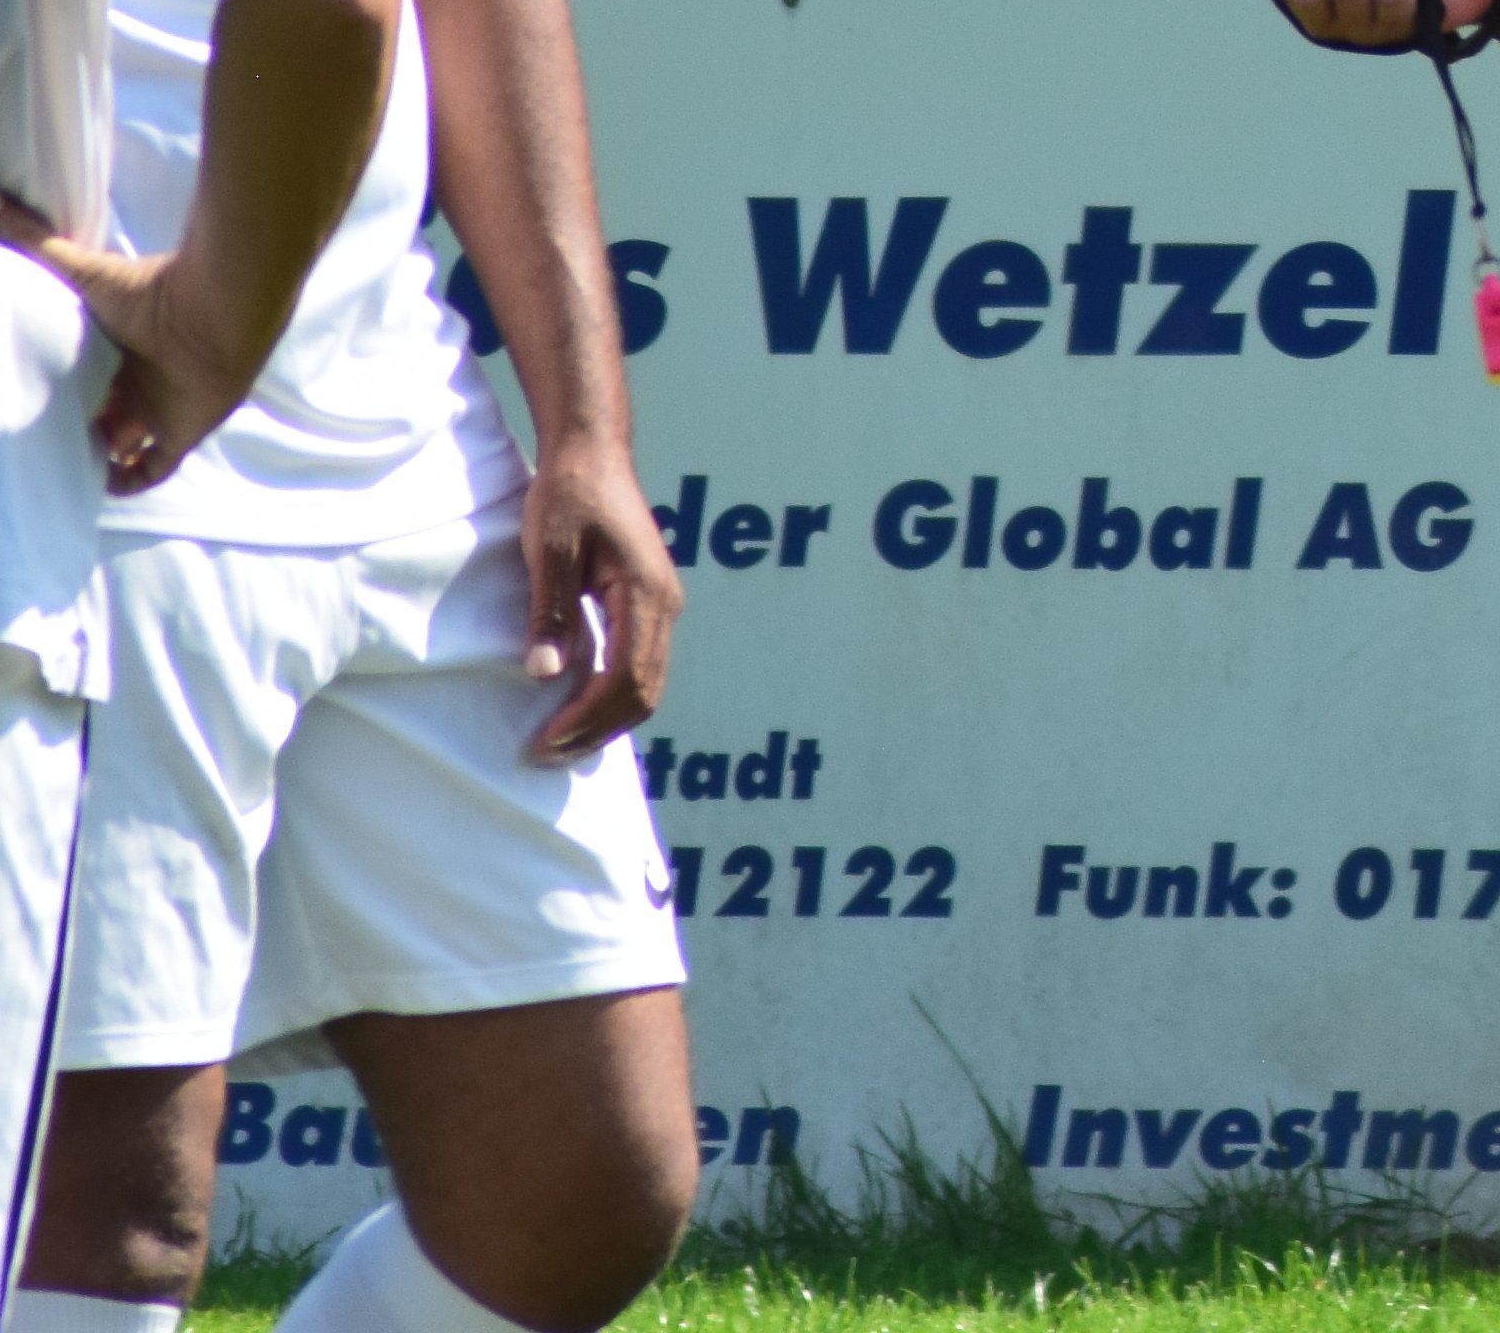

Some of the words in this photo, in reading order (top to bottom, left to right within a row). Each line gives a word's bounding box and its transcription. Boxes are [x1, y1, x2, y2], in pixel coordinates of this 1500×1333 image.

[746, 189, 1458, 360] Wetzel
[872, 477, 1262, 572] Global
[1296, 481, 1475, 573] AG
[636, 731, 823, 801] tadt
[1034, 842, 1298, 920] Funk:
